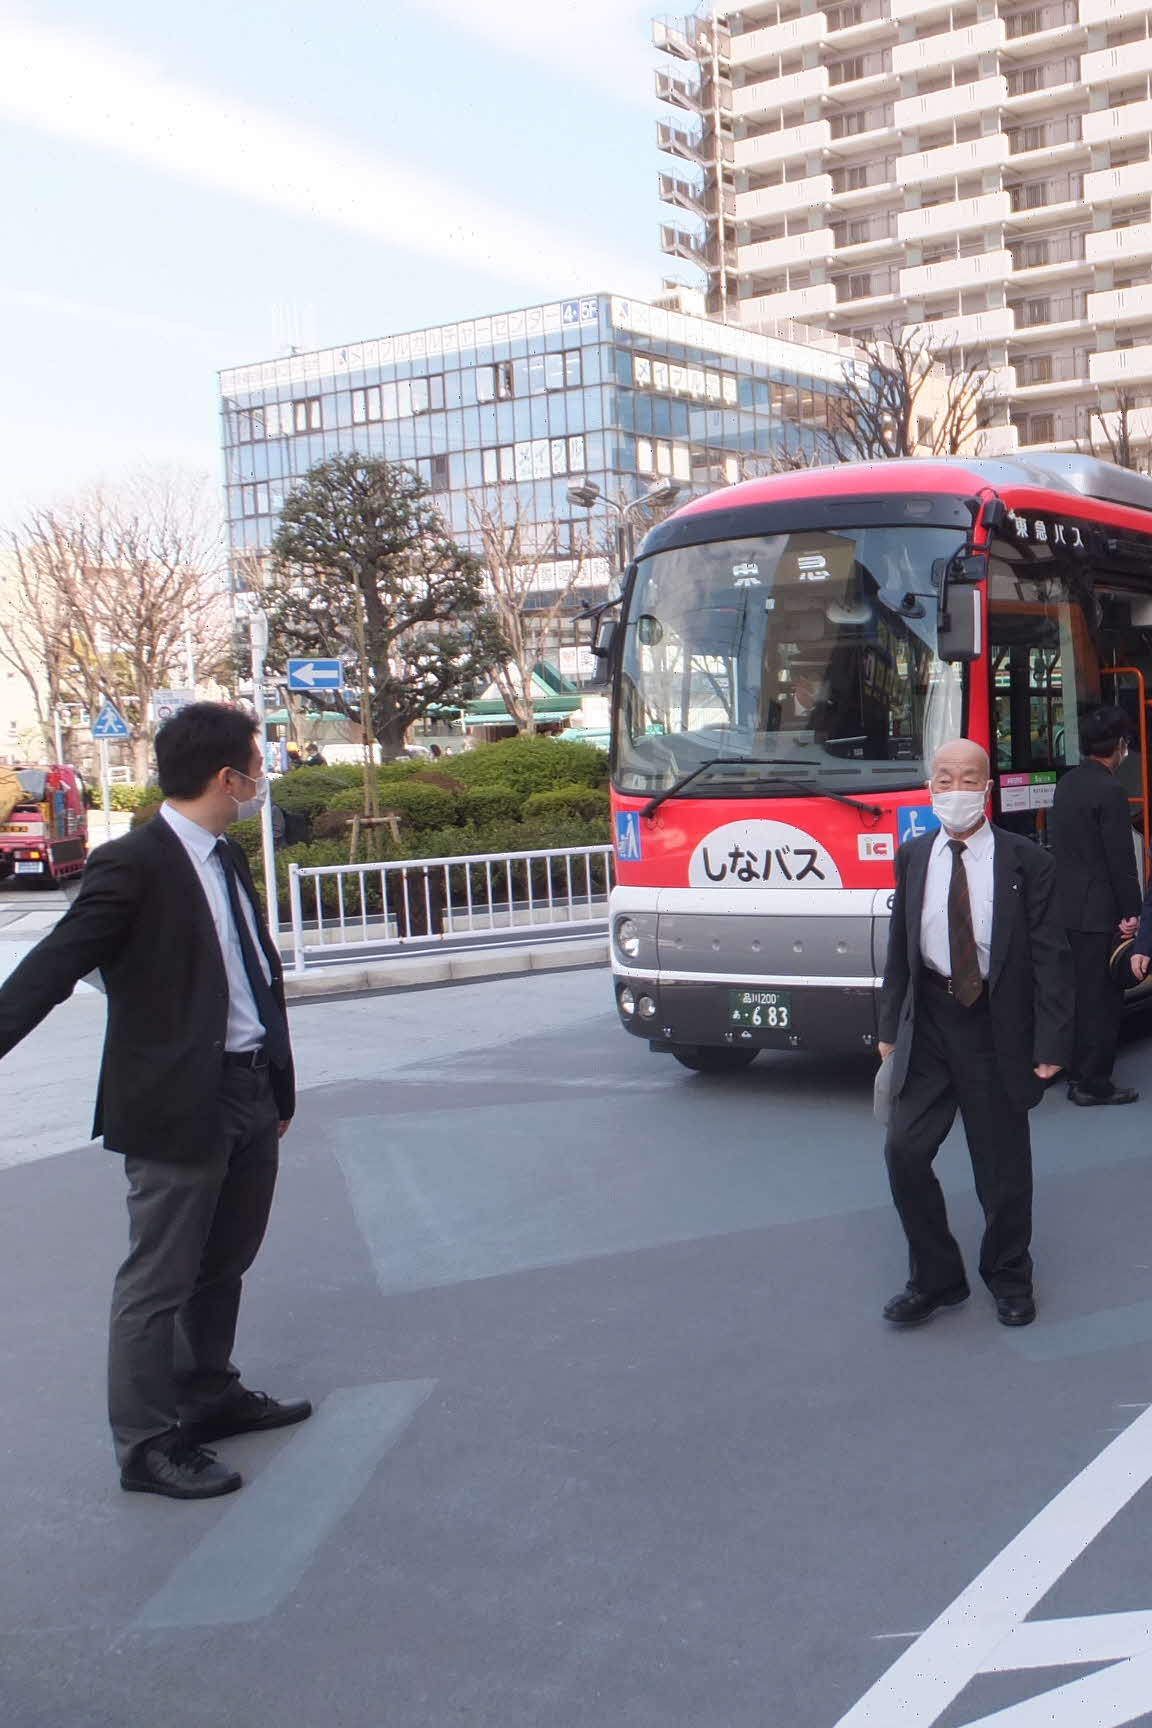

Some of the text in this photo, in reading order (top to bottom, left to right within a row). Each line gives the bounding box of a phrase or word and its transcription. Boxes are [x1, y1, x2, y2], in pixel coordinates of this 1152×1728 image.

[1015, 516, 1085, 548] 東急バス
[702, 845, 826, 883] しなバス
[742, 992, 777, 1004] 品川200
